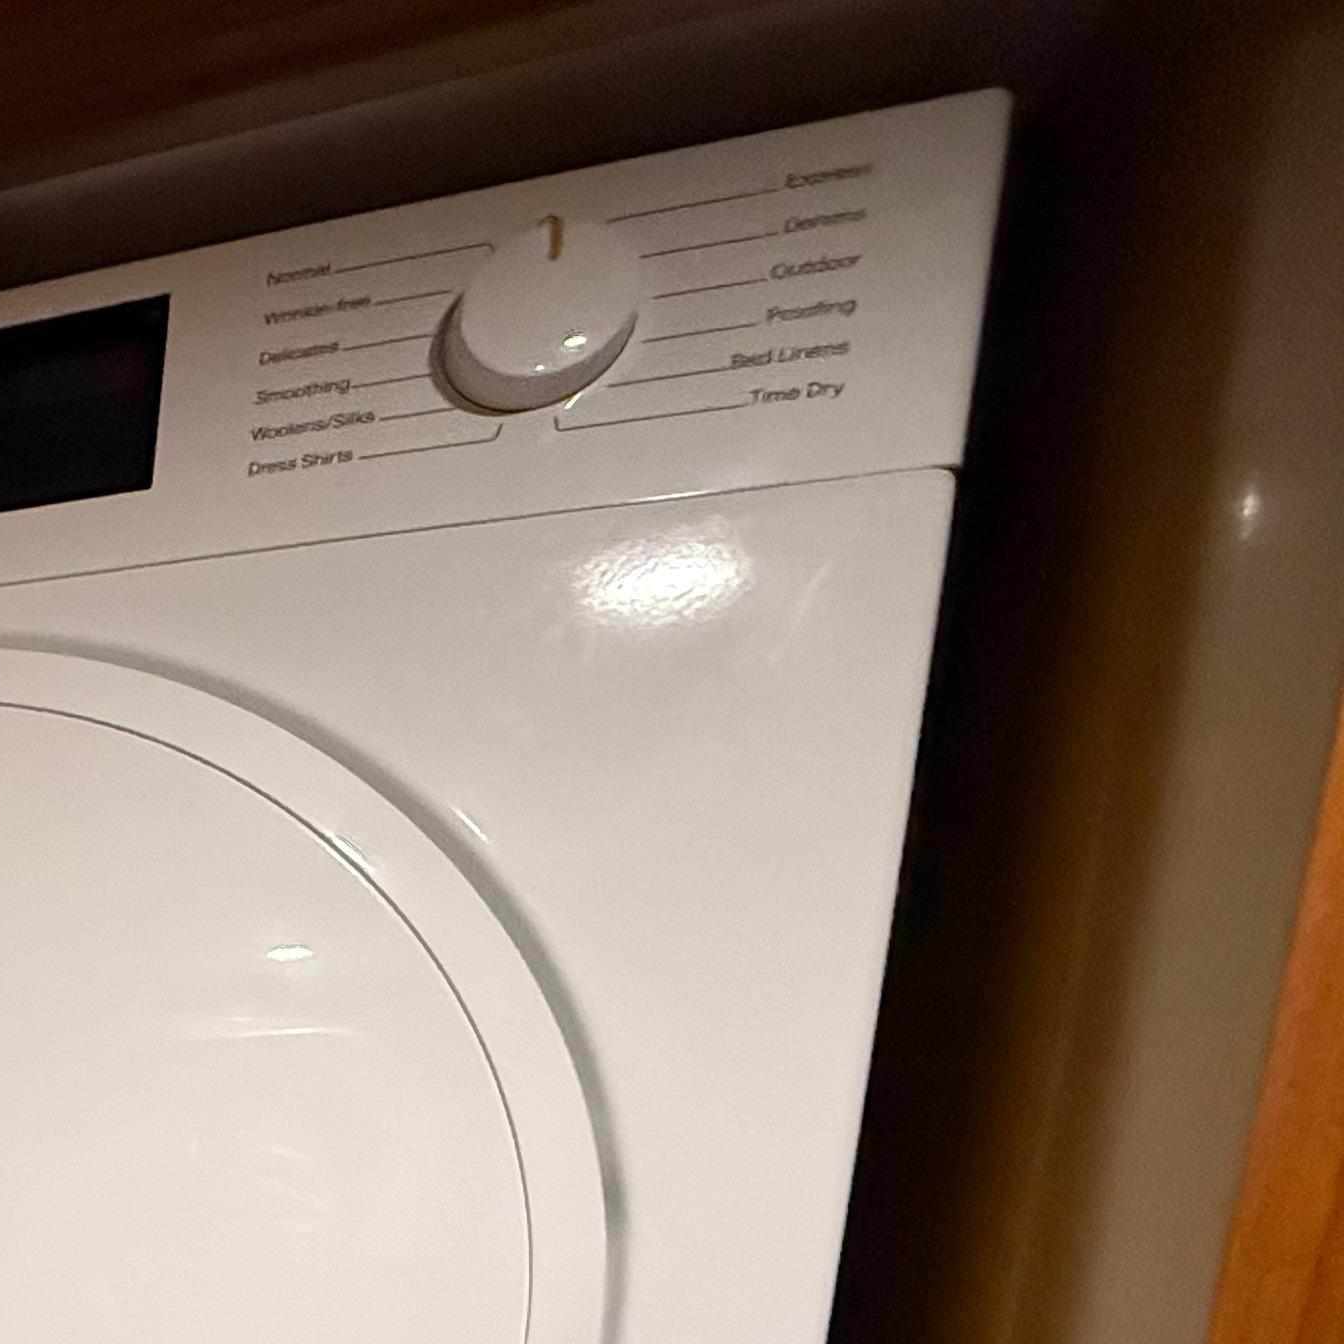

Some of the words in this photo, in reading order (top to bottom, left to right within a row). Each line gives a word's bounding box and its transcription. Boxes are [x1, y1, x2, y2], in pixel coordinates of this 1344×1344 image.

[769, 254, 862, 279] Outdoor
[255, 379, 351, 405] Smoothing
[749, 387, 800, 403] Time
[807, 381, 845, 398] Dry
[251, 411, 375, 442] Woolens/Silks
[248, 458, 297, 477] Dress
[301, 450, 353, 469] Shirts
